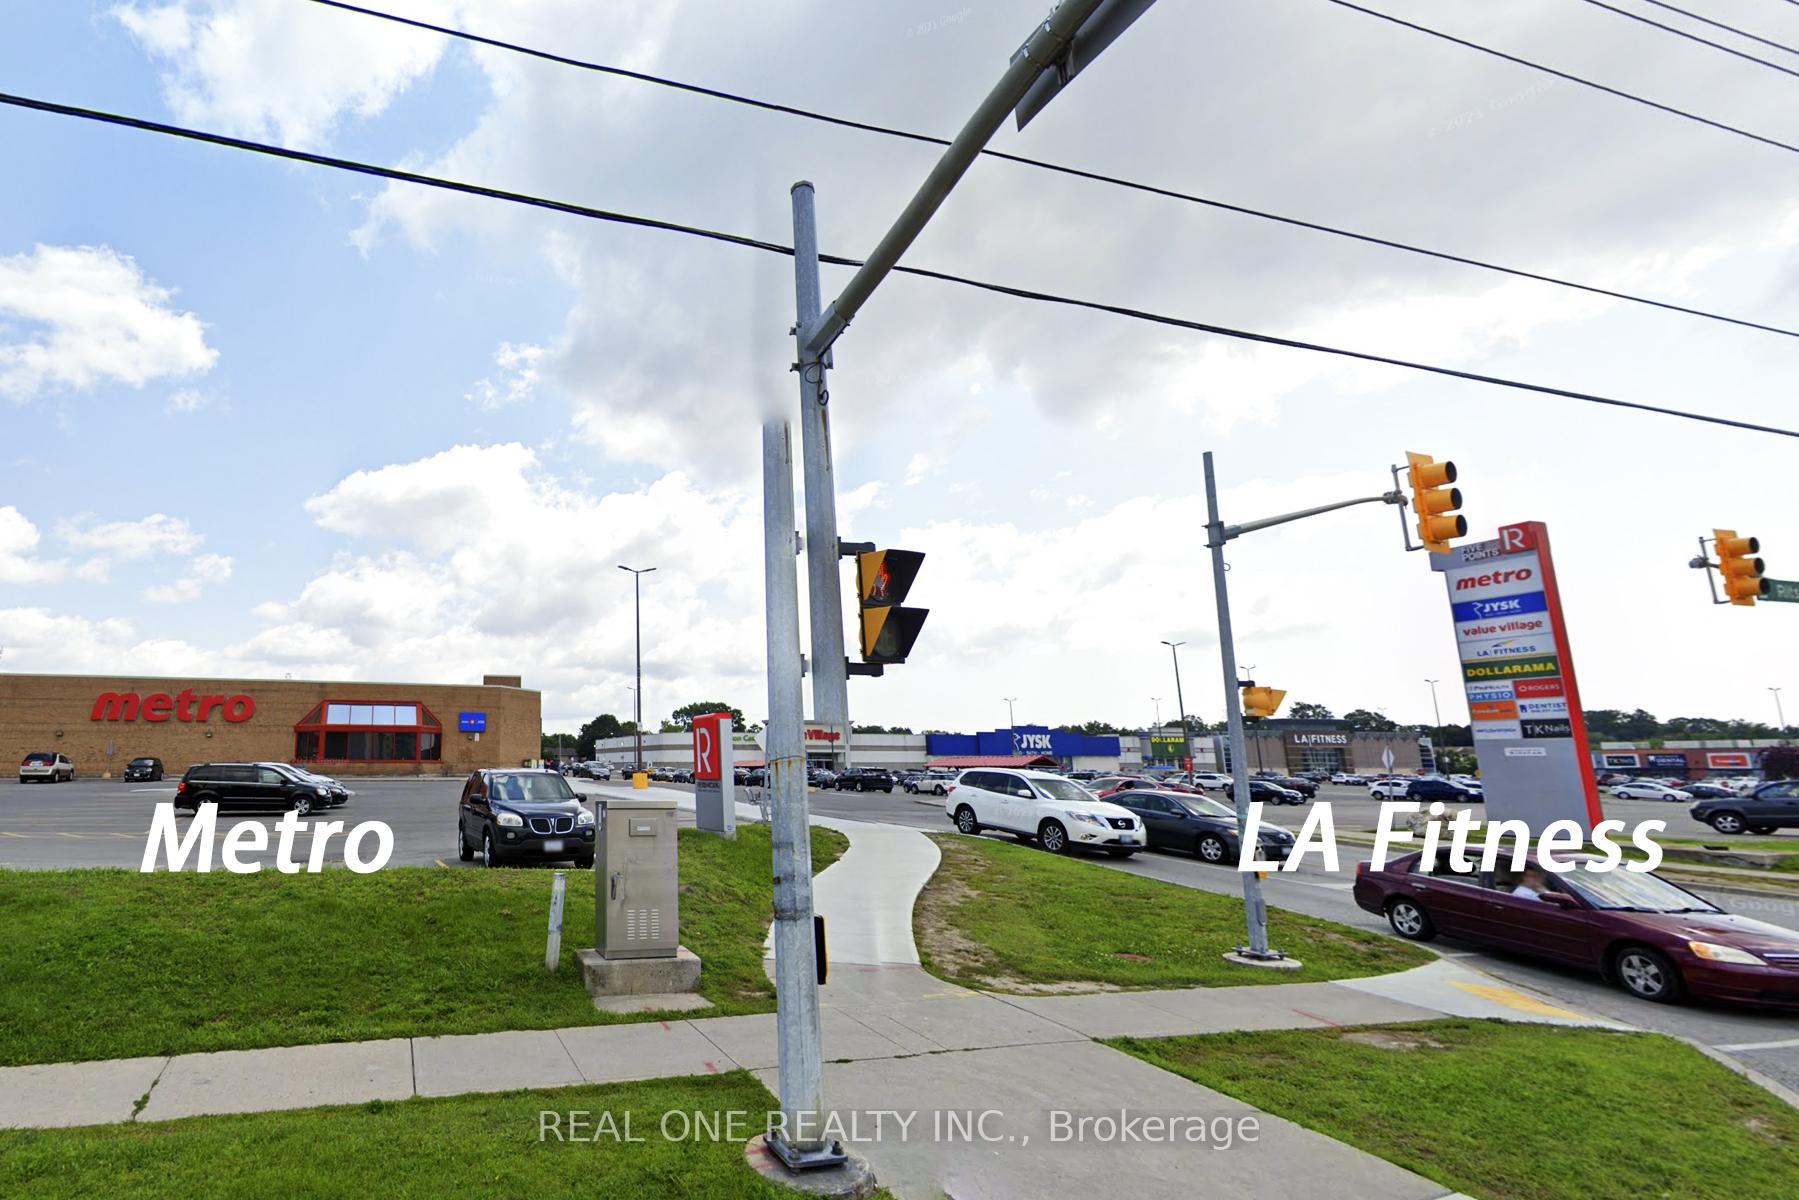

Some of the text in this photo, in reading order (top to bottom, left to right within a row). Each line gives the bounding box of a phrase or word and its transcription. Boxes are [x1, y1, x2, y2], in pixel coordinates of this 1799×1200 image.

[1462, 549, 1500, 562] POINTS
[1456, 568, 1532, 590] metro
[1483, 599, 1522, 612] JYSK
[1463, 620, 1544, 636] value village
[1493, 645, 1536, 656] FITNESS
[1466, 662, 1556, 677] DOLLARAMA
[1469, 691, 1511, 700] PHYSIO
[91, 688, 257, 723] metro
[1528, 702, 1567, 710] DENTIST
[1021, 734, 1052, 749] JYSK
[1294, 734, 1348, 744] LA FITNESS
